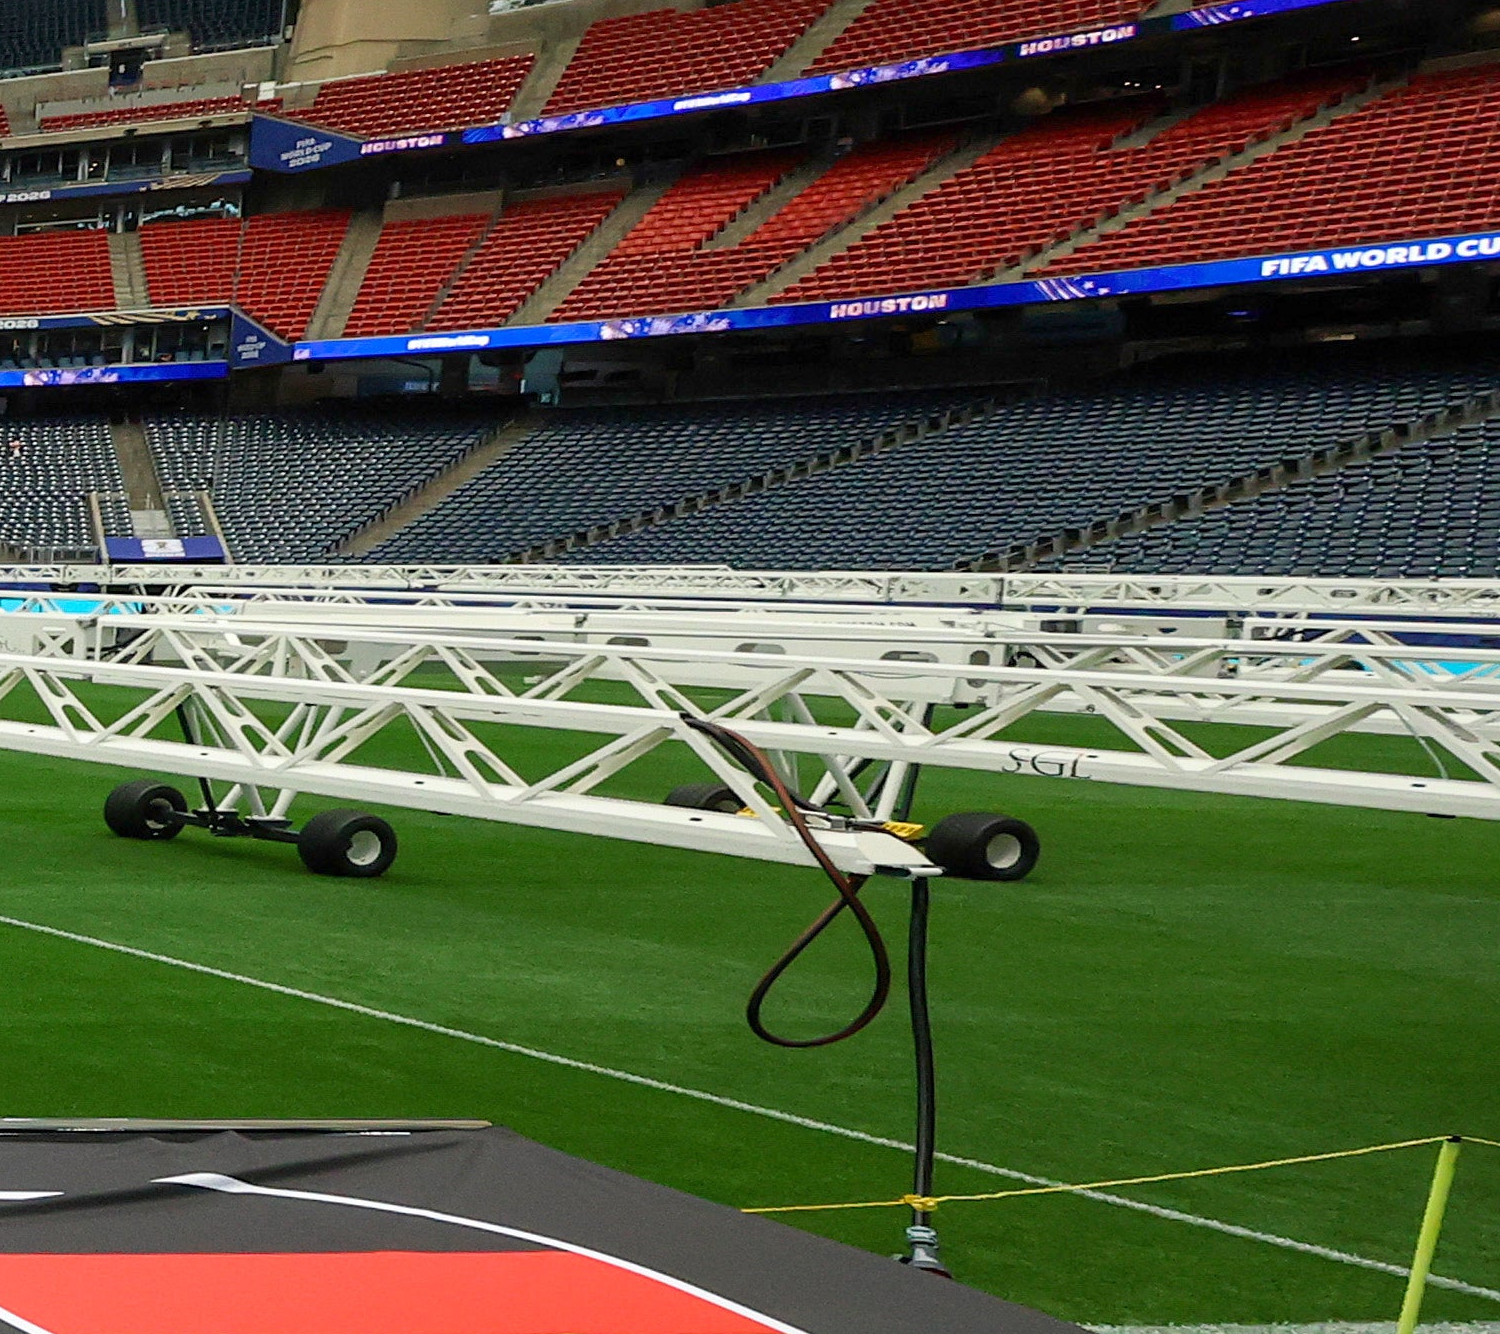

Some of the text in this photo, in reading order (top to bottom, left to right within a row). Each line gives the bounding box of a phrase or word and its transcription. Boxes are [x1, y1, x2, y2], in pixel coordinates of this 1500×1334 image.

[1020, 25, 1136, 56] HOUSTON
[360, 135, 444, 155] HOUSTON
[6, 190, 51, 202] 2026
[1261, 255, 1328, 277] FIFA
[1331, 242, 1451, 269] WORLD
[830, 293, 947, 318] HOUSTON
[1002, 748, 1093, 779] SGL
